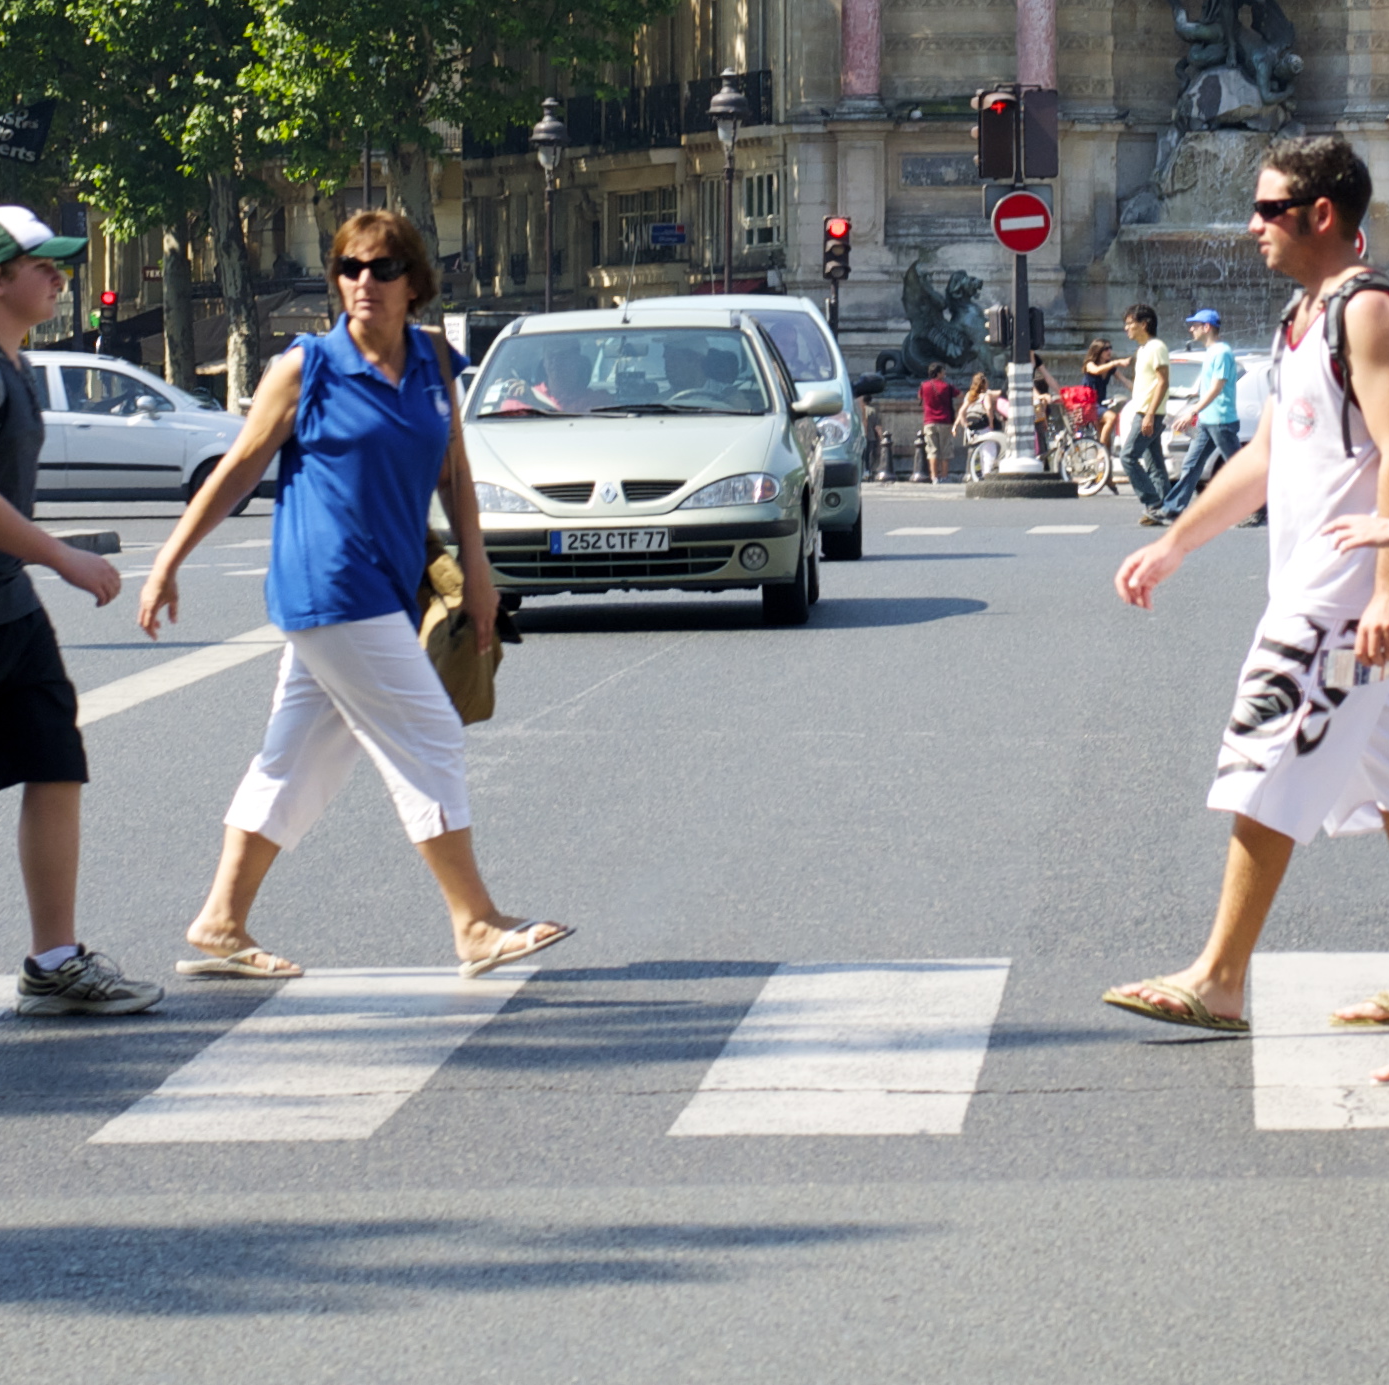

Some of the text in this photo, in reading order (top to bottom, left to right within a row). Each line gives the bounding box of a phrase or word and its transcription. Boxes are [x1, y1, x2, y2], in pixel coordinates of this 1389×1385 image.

[567, 530, 667, 551] 252 CTF 77
